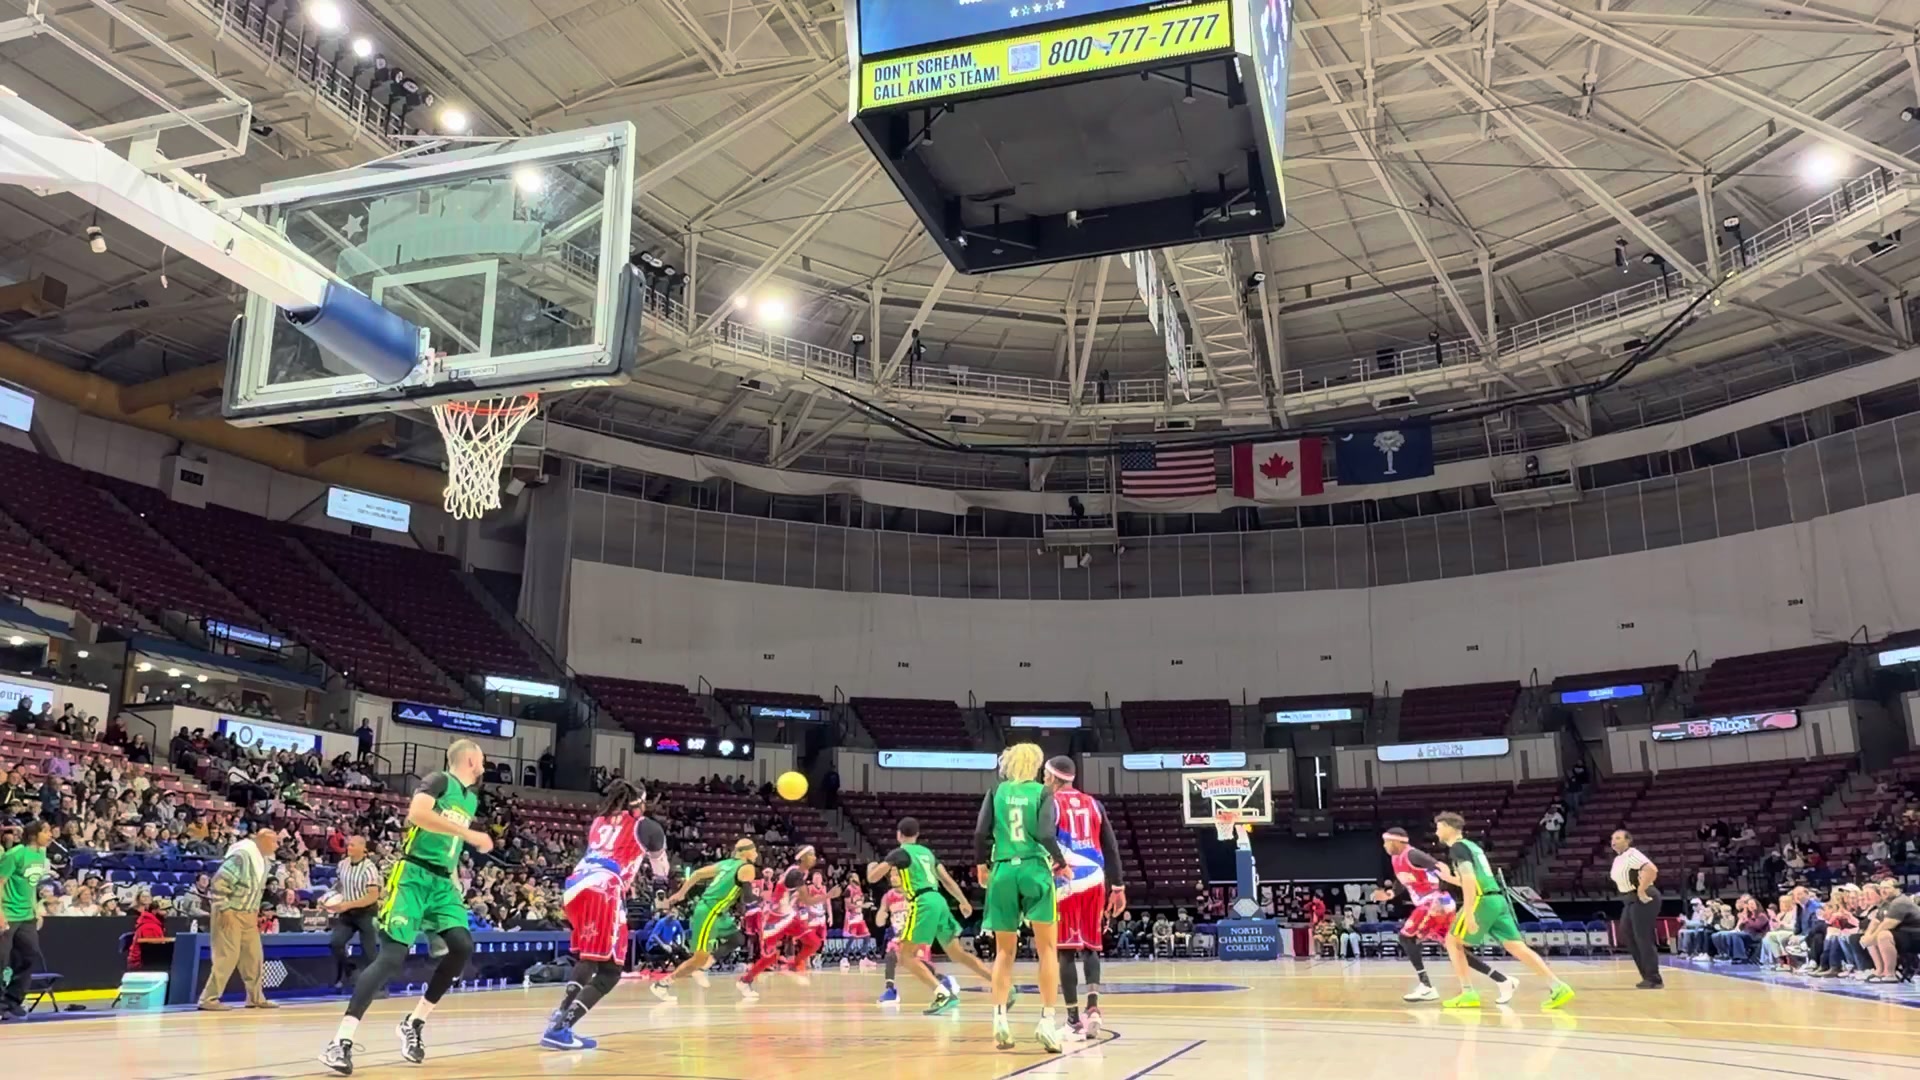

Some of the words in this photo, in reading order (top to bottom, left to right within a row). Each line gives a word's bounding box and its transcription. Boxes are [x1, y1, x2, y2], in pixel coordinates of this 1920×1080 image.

[874, 62, 914, 83] DON'T
[917, 51, 977, 76] SCREAM,
[873, 83, 905, 101] CALL
[908, 73, 956, 95] AKIM'S
[960, 66, 1000, 87] TEAM!
[1009, 807, 1026, 842] 2
[1066, 807, 1091, 839] 17
[590, 825, 624, 851] 31
[1218, 935, 1276, 944] CHARLESTON
[1230, 927, 1263, 936] NORTH
[1226, 944, 1270, 953] COLISEUM
[406, 977, 508, 996] COSEUM
